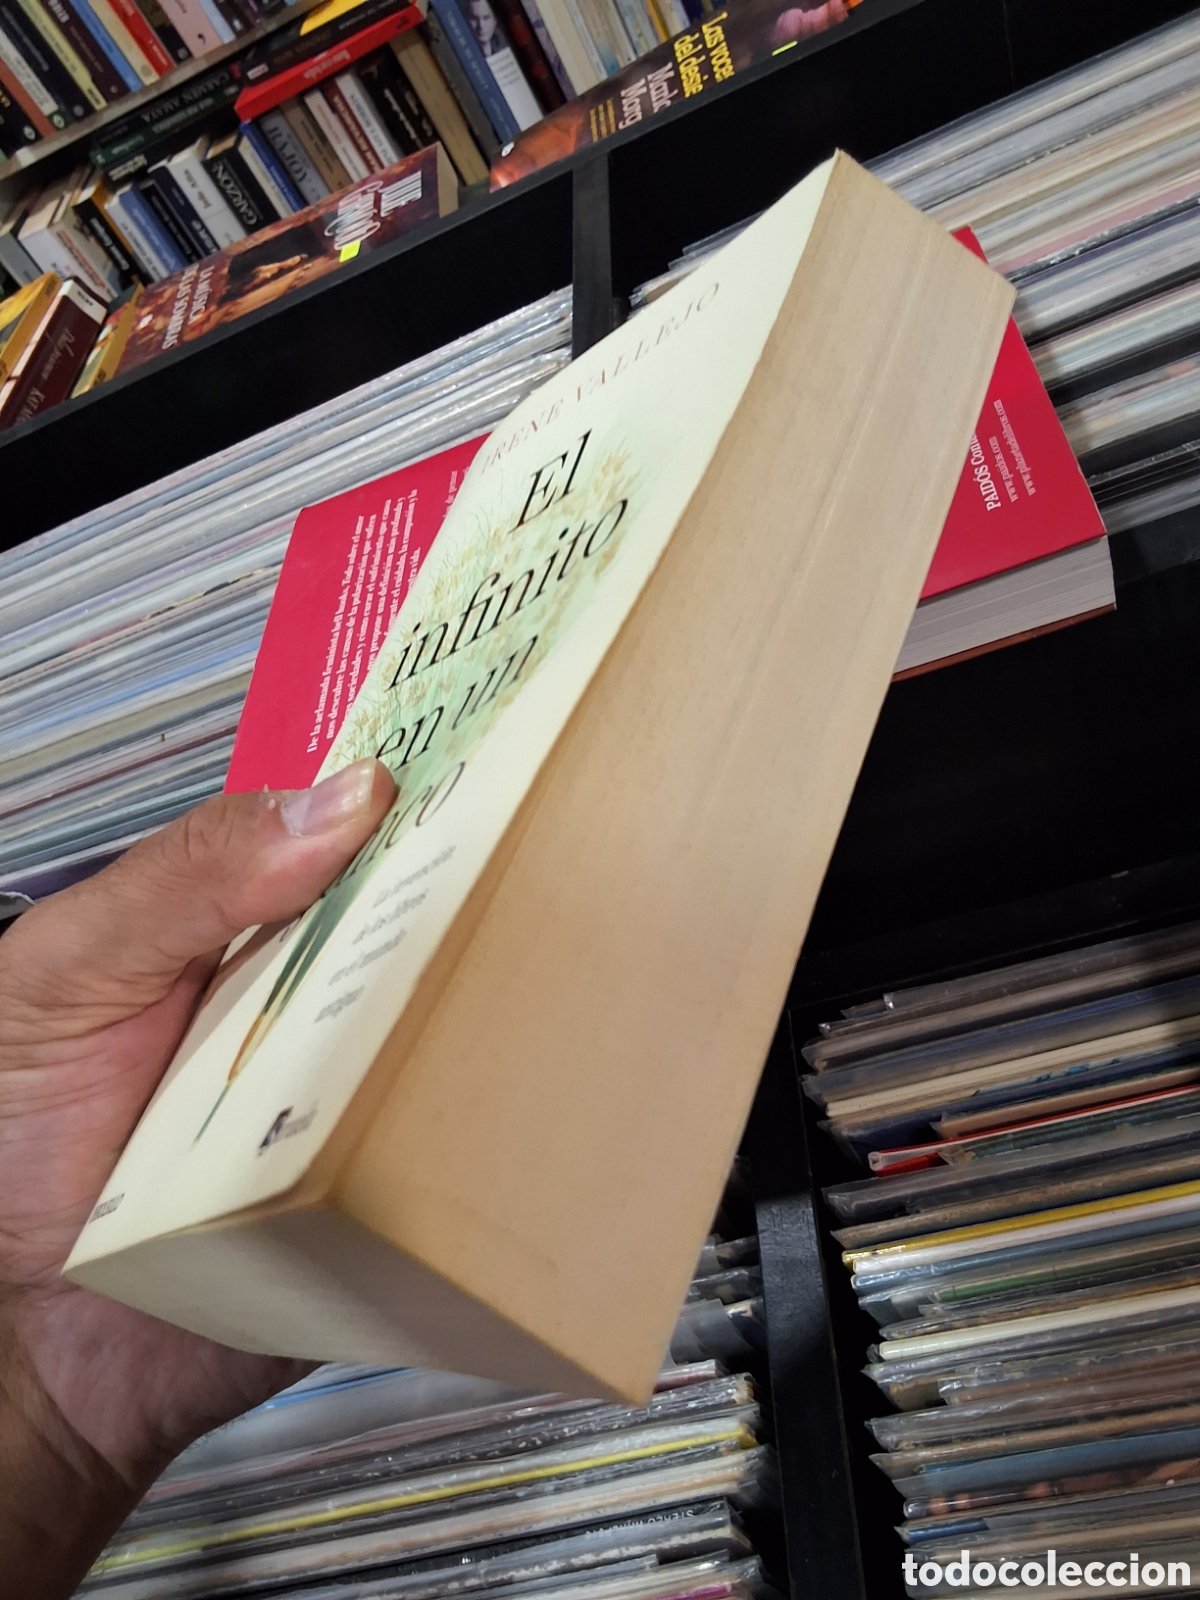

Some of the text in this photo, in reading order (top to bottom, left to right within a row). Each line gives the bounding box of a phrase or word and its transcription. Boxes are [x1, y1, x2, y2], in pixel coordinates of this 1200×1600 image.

[673, 32, 703, 63] del
[701, 11, 735, 83] Las voce
[266, 126, 308, 183] RAJOY
[211, 158, 258, 225] GARZÓN
[480, 282, 720, 475] IRENE VALLEJO
[508, 428, 592, 534] El
[990, 437, 1018, 502] www.paidos.com
[994, 400, 1035, 495] www.planetadelibros.com
[973, 464, 1001, 511] PAIDÓS
[385, 498, 628, 691] infinito
[375, 634, 539, 772] en un
